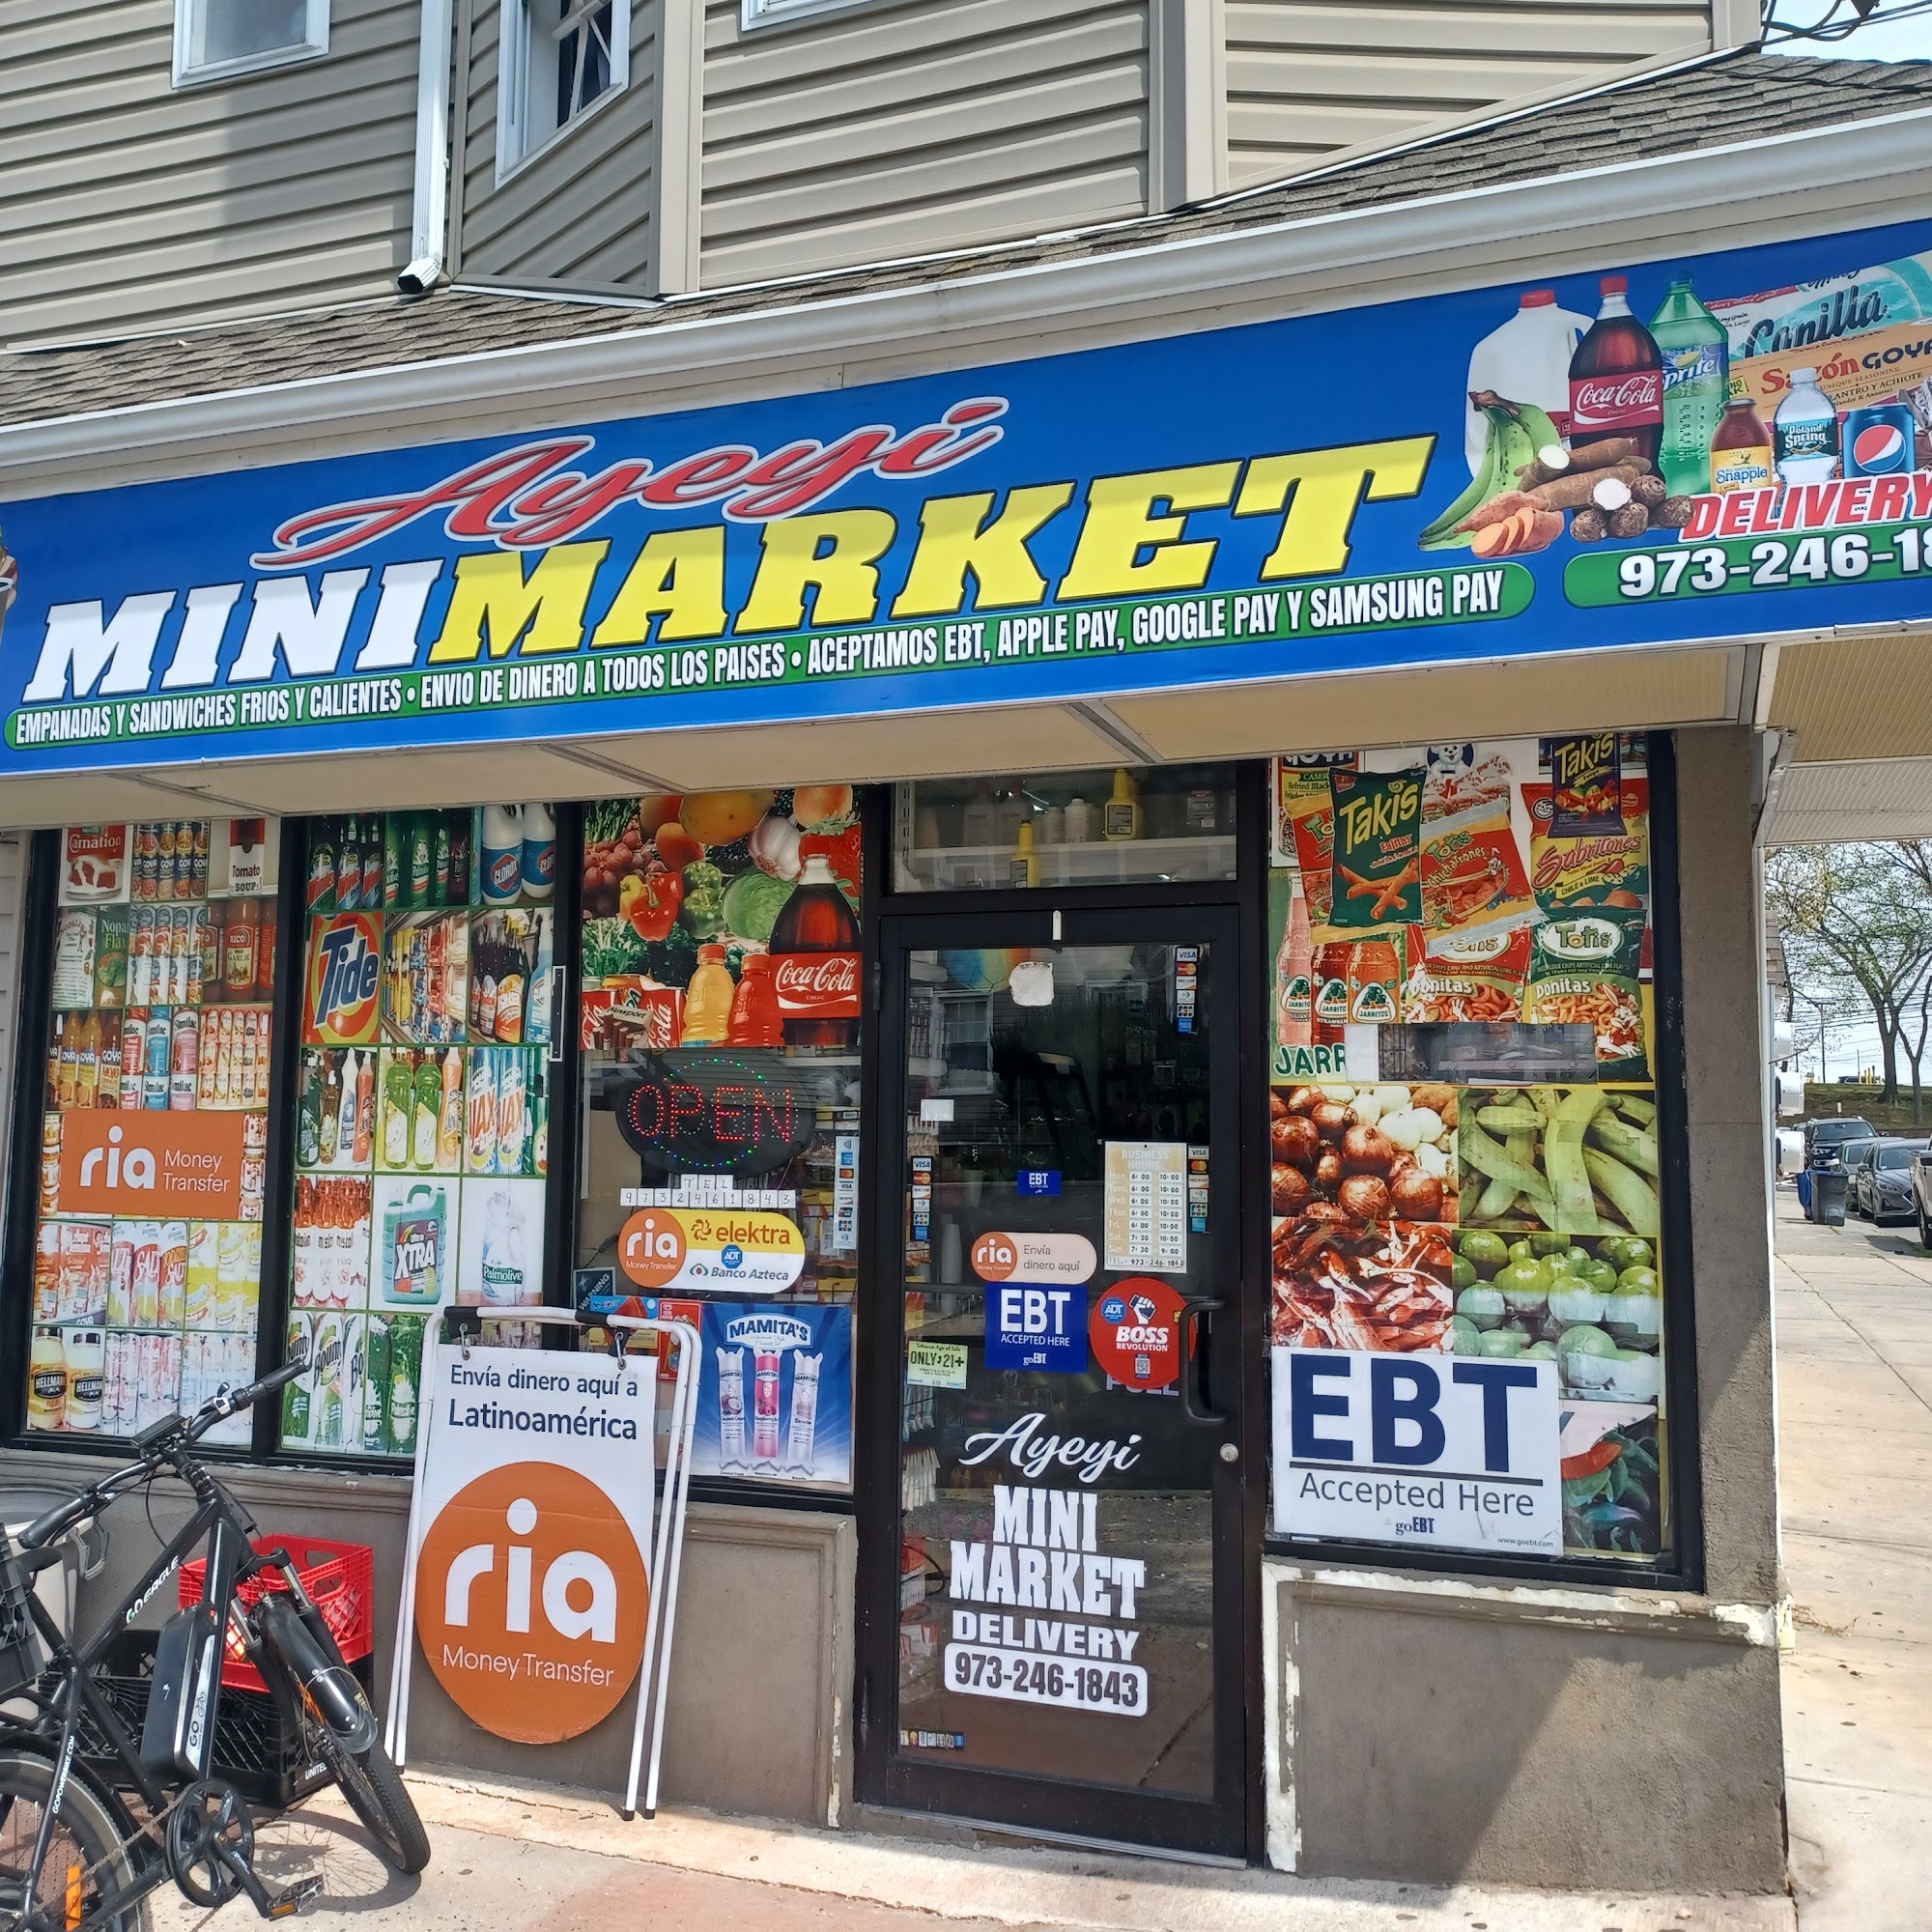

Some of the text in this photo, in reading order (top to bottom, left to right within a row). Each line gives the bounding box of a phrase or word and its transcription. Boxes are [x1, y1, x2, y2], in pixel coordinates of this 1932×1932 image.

[1744, 284, 1888, 360] Canilla
[1820, 366, 1900, 391] UNIQUE SEASONING
[1830, 385, 1870, 401] LANTRO
[1878, 371, 1924, 388] ACHIOTE
[1577, 375, 1659, 412] Coca-Cola
[1785, 432, 1827, 449] Spring
[1789, 423, 1822, 438] Poland
[249, 397, 1009, 570] Ayeyi
[1716, 467, 1768, 485] Snapple
[1679, 473, 1932, 542] DELIVERY
[15, 570, 1504, 745] EMPANADAS Y SANDWICHES FRIOS Y CALIENTES ENVIO DE DINERO A TODOS LOS PAISES ACEPTAMOS EBT, APPLE PAY, GOOGLE PAY Y SAMSUNG PAY
[1554, 733, 1614, 784] Takis
[1289, 781, 1330, 790] Refried Black
[1339, 780, 1419, 855] Takis
[70, 834, 122, 853] Carnation
[232, 865, 261, 878] Tomato
[494, 860, 519, 884] CLOROX
[1532, 836, 1642, 890] Sabritones
[235, 881, 256, 893] SOUP
[1562, 875, 1600, 895] CHILE LIME
[1555, 923, 1613, 950] Totis
[227, 951, 251, 962] GARLIC
[313, 923, 380, 1029] Tide
[776, 957, 859, 993] Coca-Cola
[1537, 978, 1591, 1000] Donitas
[175, 1016, 197, 1031] Similac
[611, 1006, 647, 1018] Newport
[102, 1050, 122, 1063] GOYA
[1275, 1044, 1347, 1074] JARR
[632, 1085, 791, 1143] OPEN
[80, 1125, 156, 1189] ria
[164, 1150, 222, 1170] Money
[1122, 1150, 1169, 1159] BUSINESS
[1128, 1160, 1164, 1170] HOURS:
[163, 1173, 230, 1193] Transfer
[1029, 1173, 1048, 1185] EBT
[627, 1218, 790, 1259] ria elektra
[395, 1238, 437, 1280] XTRA
[724, 1251, 740, 1260] ADT
[978, 1238, 1051, 1264] ria Envía
[483, 1266, 524, 1281] Palmolive
[626, 1260, 677, 1271] Money Transfer
[711, 1267, 789, 1280] Banco Azteca
[1024, 1260, 1080, 1272] dinero aquí
[1000, 1289, 1070, 1334] EBT
[1104, 1304, 1123, 1314] ADT
[729, 1319, 809, 1342] MAMITA'S
[1001, 1334, 1070, 1347] ACCEPTED HERE
[1116, 1326, 1169, 1344] BOSS
[910, 1350, 937, 1366] ONLY
[1023, 1352, 1046, 1365] goEBT
[1117, 1343, 1168, 1351] REVOLUTION
[450, 1365, 638, 1399] Envía dinero aquí a
[448, 1399, 637, 1440] Latinoamérica
[1291, 1353, 1537, 1472] EBT
[957, 1412, 1142, 1483] Ayeyi
[1299, 1472, 1534, 1516] Accepted Here
[993, 1484, 1097, 1552] MINI
[1395, 1517, 1435, 1535] goEBT
[1497, 1537, 1554, 1548] www.goebt.com
[444, 1497, 616, 1643] ria
[950, 1540, 1146, 1619] MARKET
[952, 1609, 1140, 1662] DELIVERY
[442, 1644, 614, 1687] Money Transfer
[954, 1652, 1138, 1707] 973-246-1843
